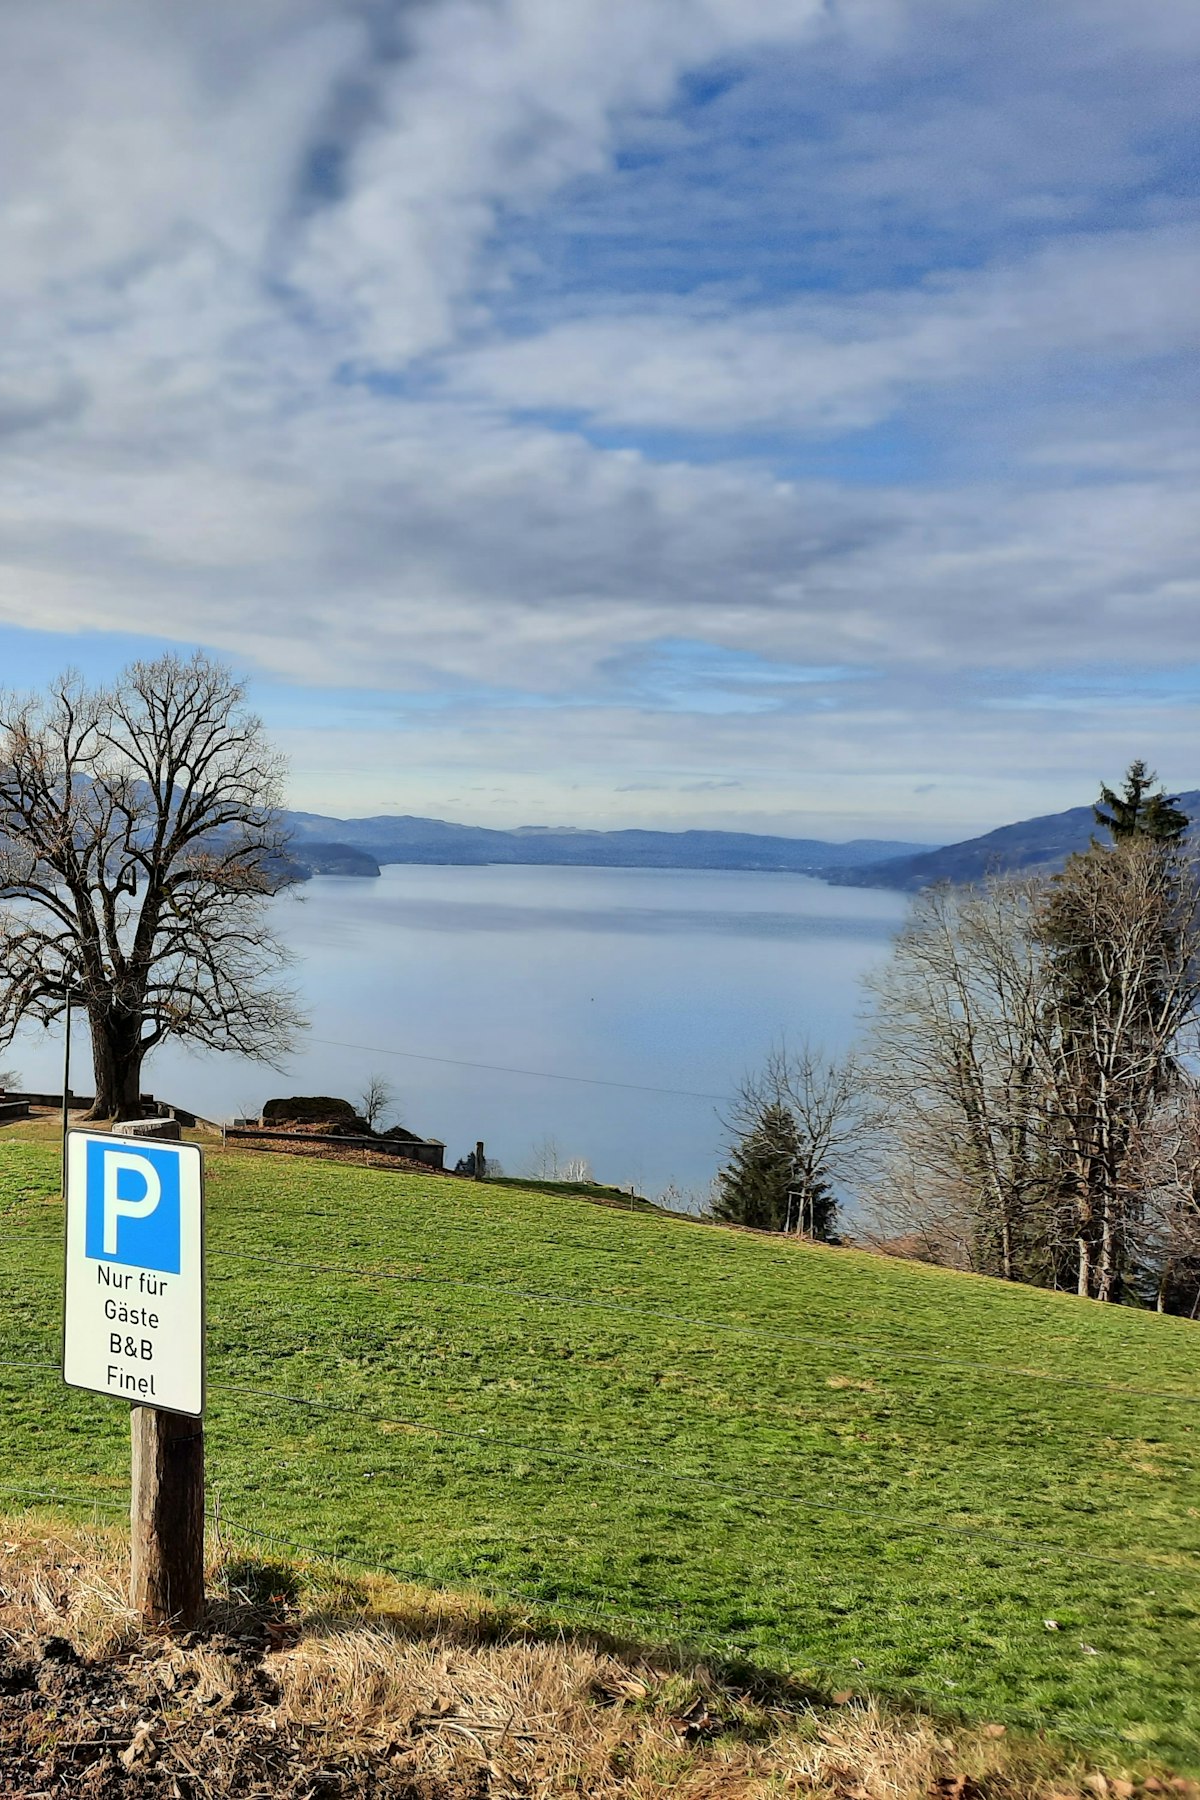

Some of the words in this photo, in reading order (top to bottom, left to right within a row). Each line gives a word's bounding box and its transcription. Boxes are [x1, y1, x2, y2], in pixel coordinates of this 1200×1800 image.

[103, 1150, 161, 1255] P
[97, 1265, 133, 1290] Nur
[139, 1272, 168, 1296] für
[104, 1299, 159, 1329] Gäste
[109, 1333, 153, 1361] B&B
[107, 1365, 156, 1396] Finel
